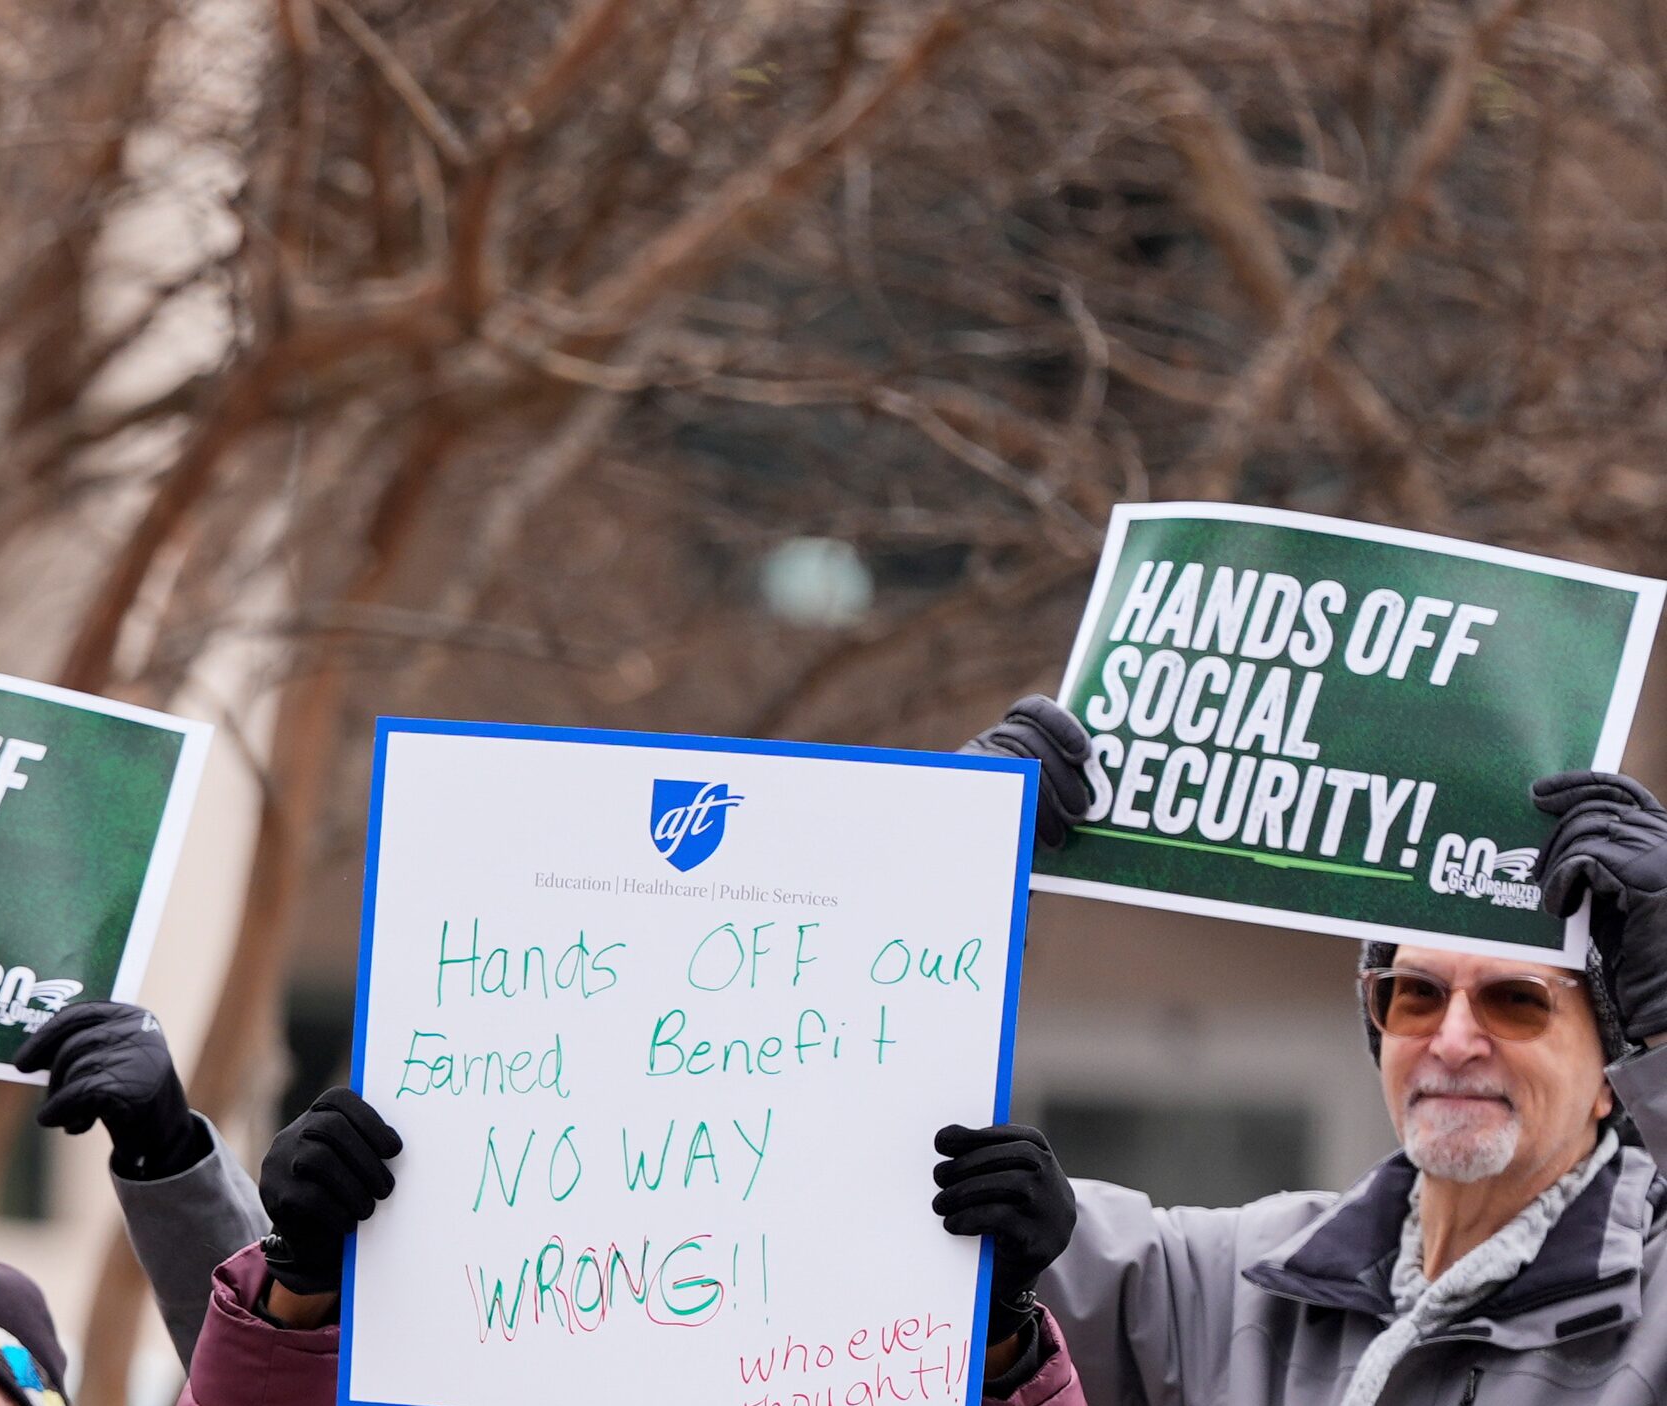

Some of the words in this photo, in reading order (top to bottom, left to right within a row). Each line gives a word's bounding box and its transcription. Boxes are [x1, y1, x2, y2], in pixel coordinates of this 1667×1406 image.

[1109, 560, 1347, 668] HANDS
[1344, 588, 1498, 686] OFF
[1086, 645, 1324, 760] SOCIAL
[654, 782, 744, 860] aft
[1084, 734, 1437, 869] SECURITY!
[534, 871, 612, 893] Education
[622, 877, 708, 899] Healthcare
[719, 883, 769, 903] Public
[772, 887, 839, 909] Services
[437, 918, 627, 1007] Hands
[688, 922, 820, 991] OFF
[396, 1030, 570, 1099] Earned
[646, 1005, 896, 1076] Benefit
[473, 1125, 581, 1213] NO
[623, 1108, 772, 1200] WAY
[466, 1234, 767, 1343] WRONG!!
